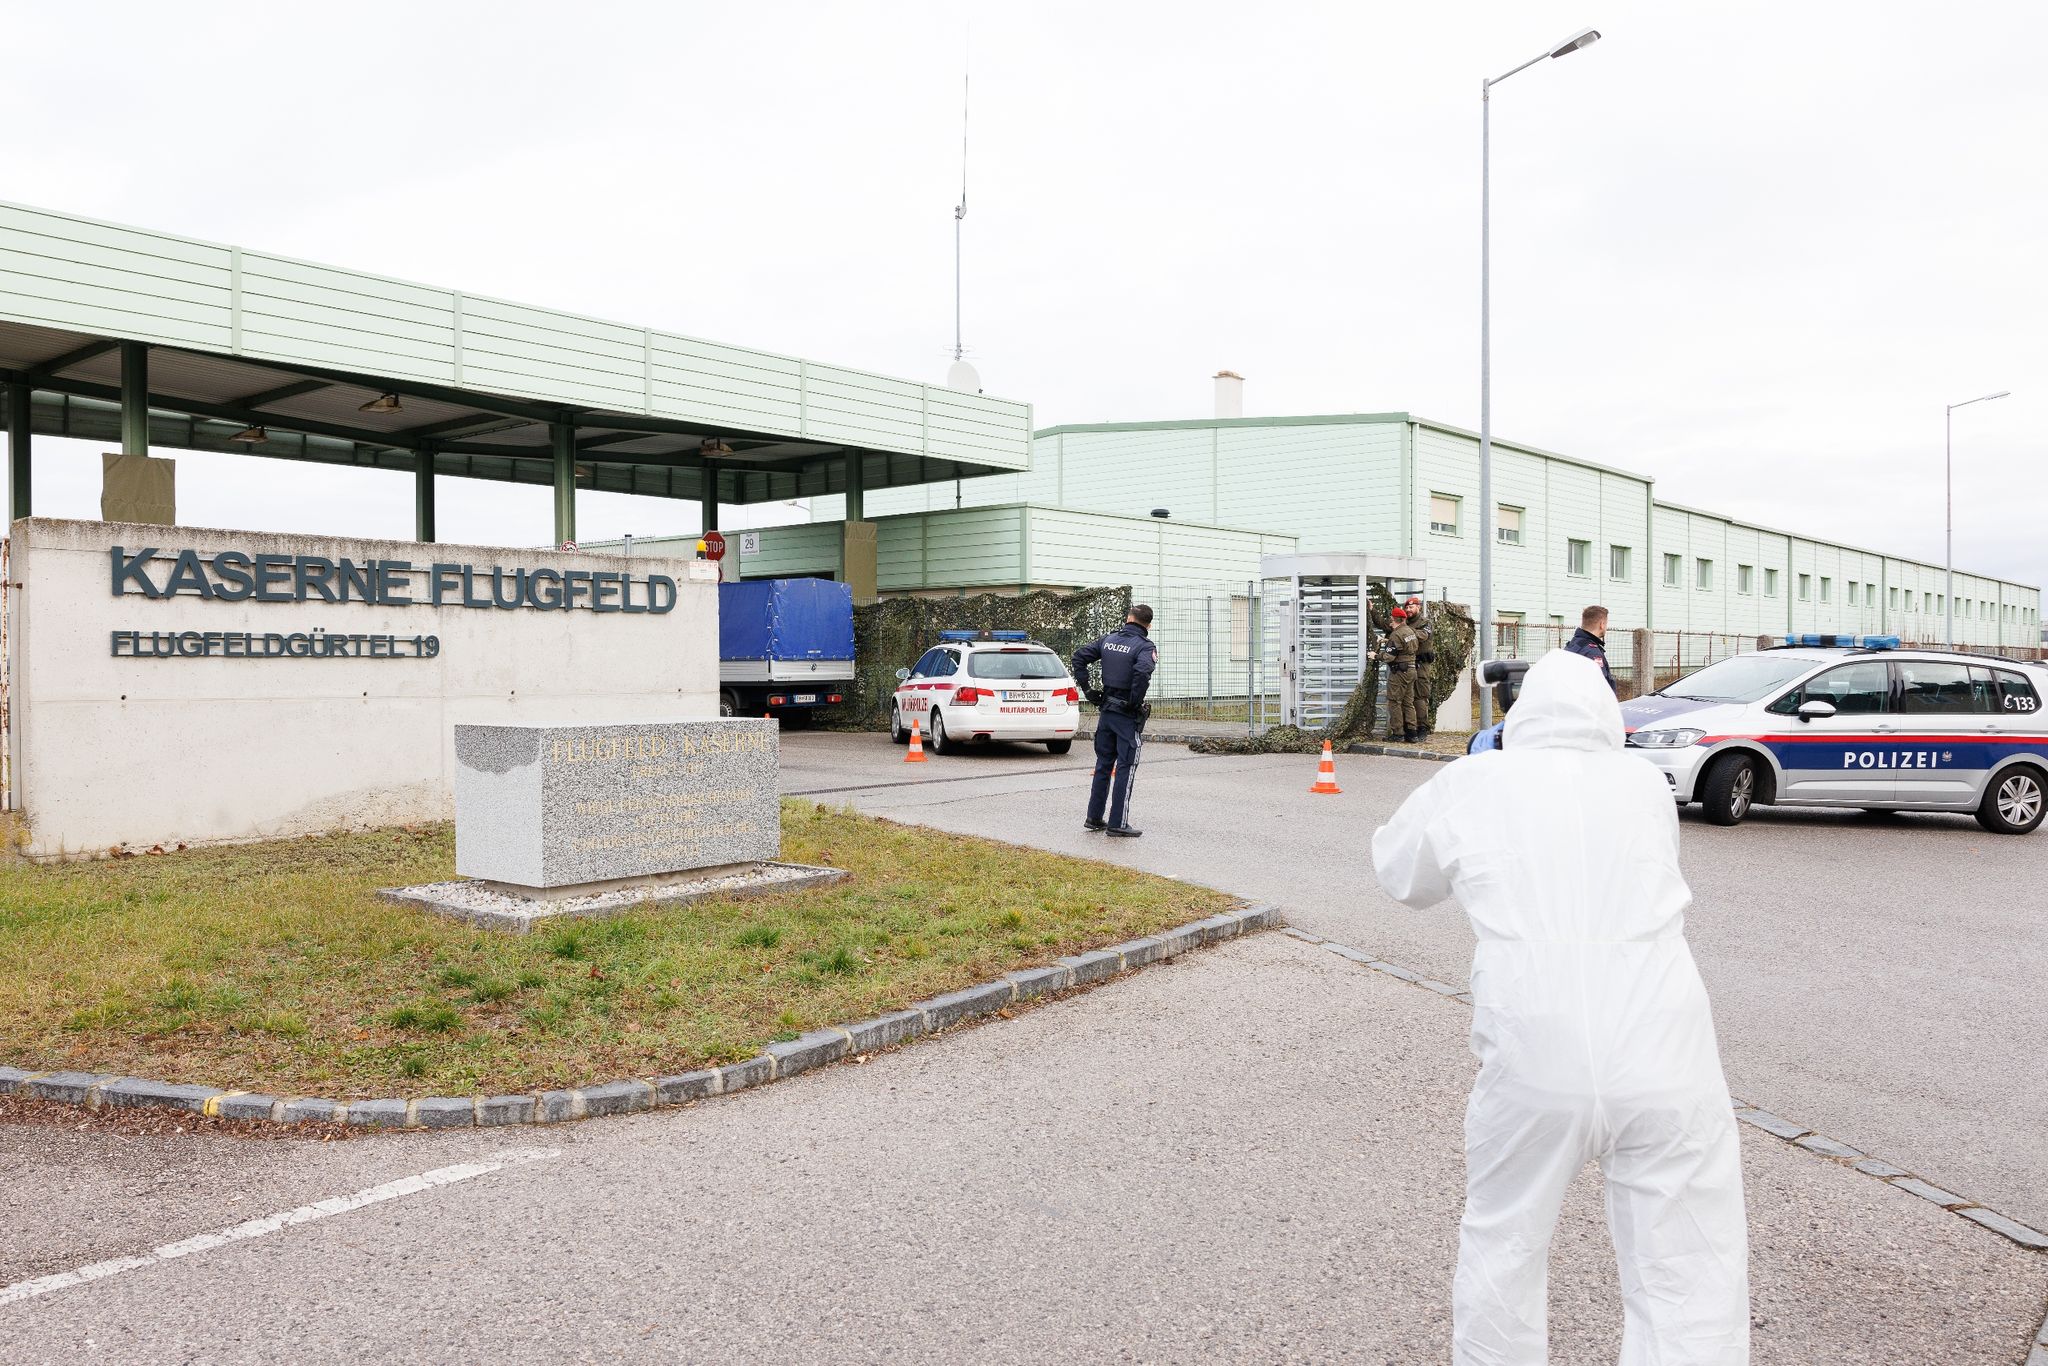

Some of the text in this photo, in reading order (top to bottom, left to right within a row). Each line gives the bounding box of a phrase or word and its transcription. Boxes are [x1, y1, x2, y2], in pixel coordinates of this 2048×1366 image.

[705, 541, 724, 553] STOP
[745, 538, 754, 549] 29
[111, 546, 677, 613] KASERNE FLUGFELD
[111, 627, 440, 658] FLUGFELDGÜRTEL 19
[1103, 642, 1131, 654] POLIZEI
[2013, 696, 2036, 711] 133
[1843, 751, 1938, 769] POLIZEI
